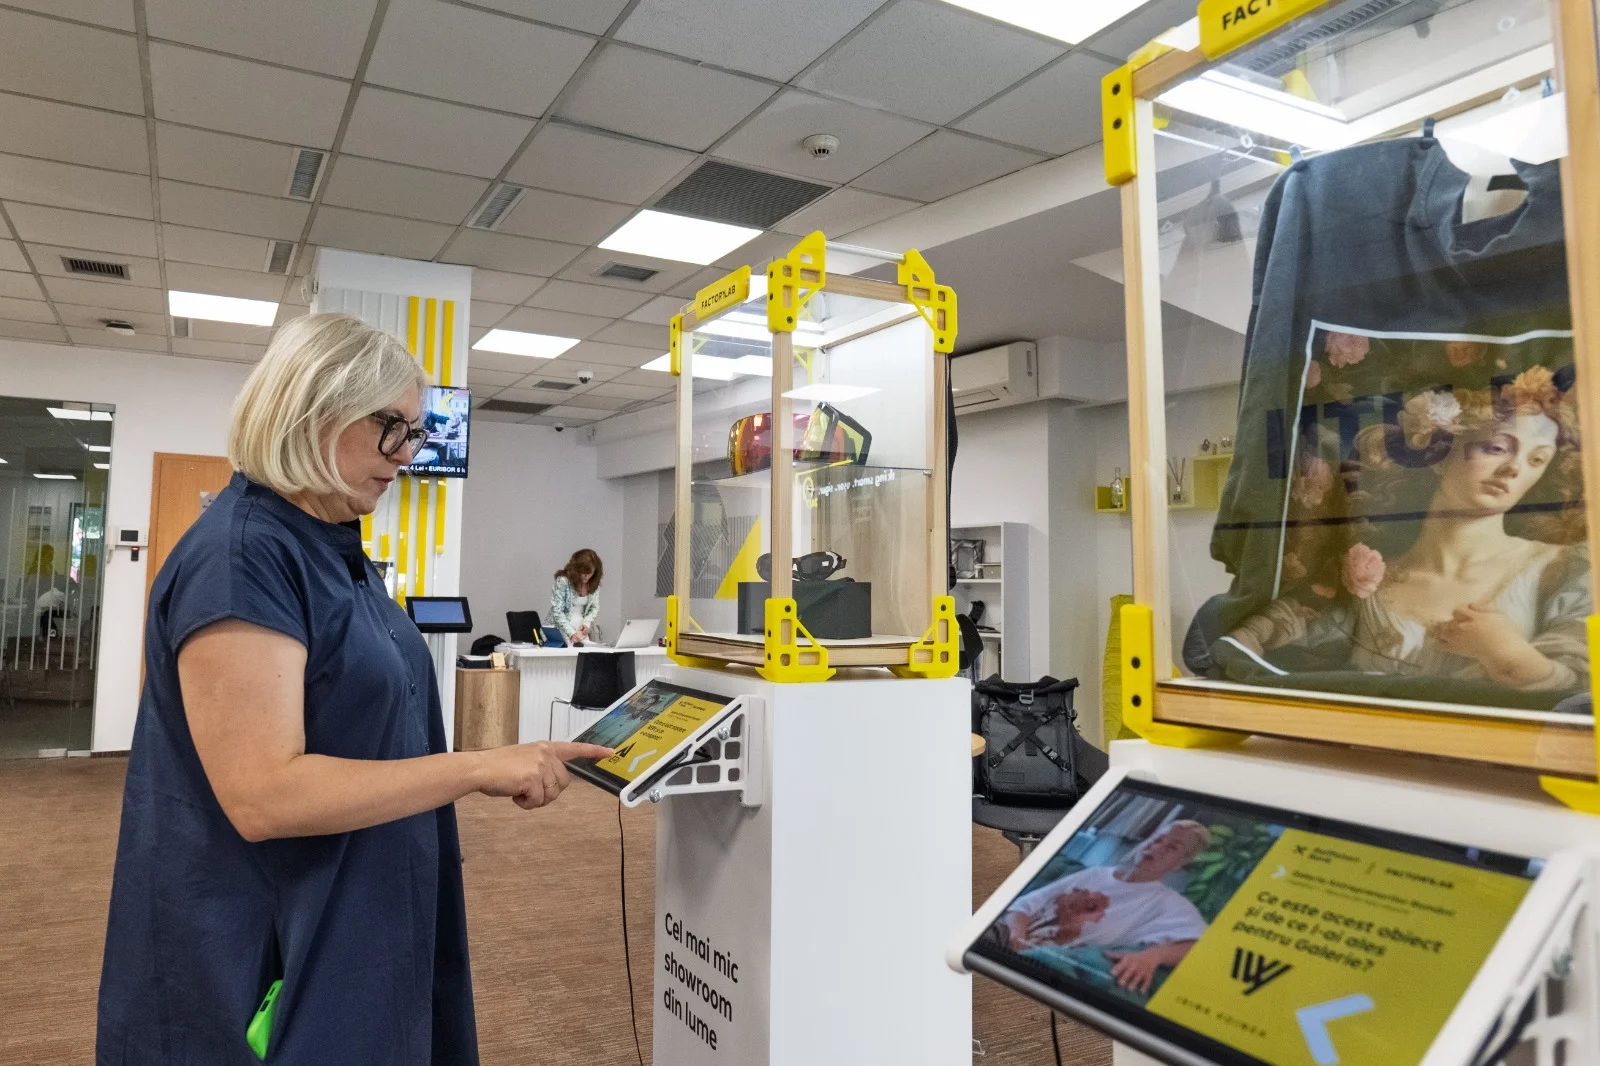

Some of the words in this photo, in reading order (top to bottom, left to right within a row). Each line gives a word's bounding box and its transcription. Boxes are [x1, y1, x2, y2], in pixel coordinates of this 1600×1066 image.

[665, 912, 683, 944] Cel
[686, 930, 710, 963] mai
[713, 949, 739, 983] mic
[1232, 920, 1293, 947] pentru
[1294, 937, 1375, 972] Galerie?
[1256, 891, 1279, 905] Ce
[1281, 899, 1320, 917] este
[1322, 910, 1375, 933] acest
[1377, 926, 1444, 954] obiect
[1262, 910, 1285, 925] de
[1286, 918, 1308, 932] ce
[1345, 935, 1386, 957] ales
[664, 951, 732, 1022] showroom
[664, 987, 682, 1020] din
[685, 1001, 717, 1051] lume
